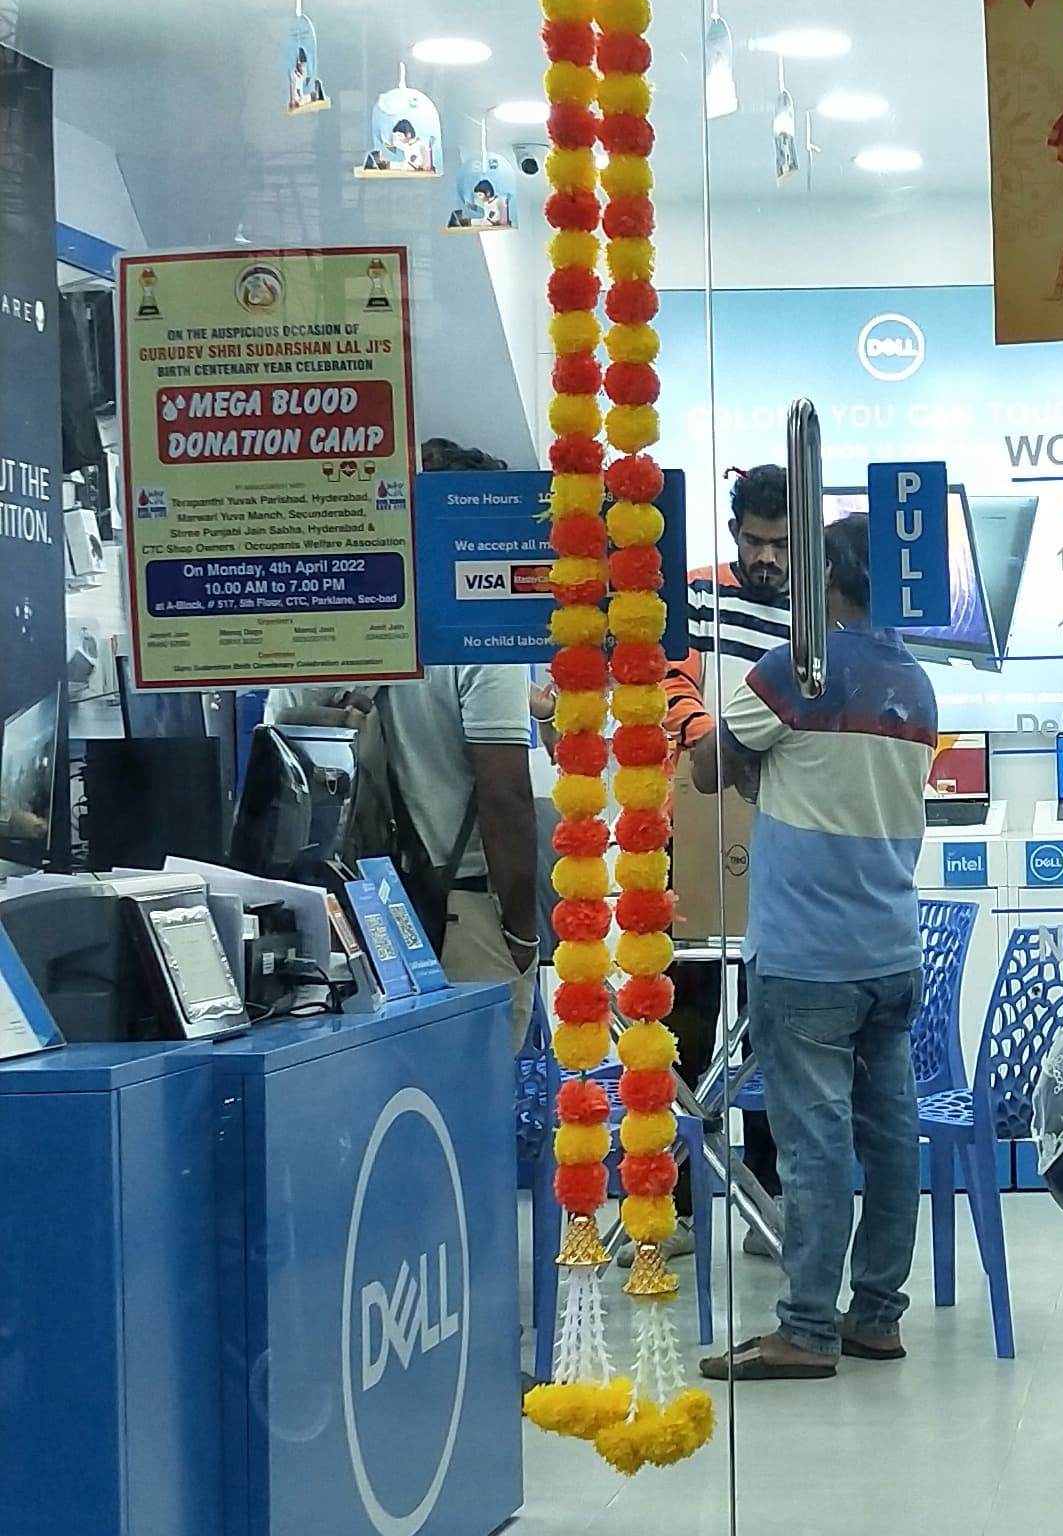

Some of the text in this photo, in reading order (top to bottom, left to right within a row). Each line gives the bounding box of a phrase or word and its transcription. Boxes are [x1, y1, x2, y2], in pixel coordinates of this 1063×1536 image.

[167, 323, 360, 341] ON THE AUSPICIOUS OCCASION OF
[139, 339, 392, 361] GURUDEV SHRI SUDARSHAN LAL JI'S
[157, 359, 373, 378] BIRTH CENTENARY YEAR CELEBRATION
[188, 387, 358, 418] MEGA BLOOD
[831, 404, 894, 427] YOU
[168, 425, 384, 459] DONATION CAMP
[19, 462, 50, 500] THE
[227, 496, 257, 505] Yuvak
[447, 493, 480, 505] Store
[482, 493, 522, 505] Hours:
[221, 512, 245, 521] Yuva
[244, 527, 266, 535] Jain
[308, 524, 364, 535] Hyderabad
[368, 523, 375, 531] &
[345, 538, 406, 547] Association
[454, 540, 475, 552] We
[477, 540, 518, 553] accept
[521, 539, 536, 550] all
[896, 471, 924, 618] PULL
[183, 559, 365, 578] On Monday, 4th April 2022
[205, 578, 345, 595] 10.00 AM to 7.00 PM
[464, 574, 506, 590] VISA
[463, 636, 481, 647] No
[484, 635, 514, 647] child
[947, 853, 984, 872] intel
[1035, 858, 1062, 869] DELL
[361, 1242, 459, 1392] DELL
